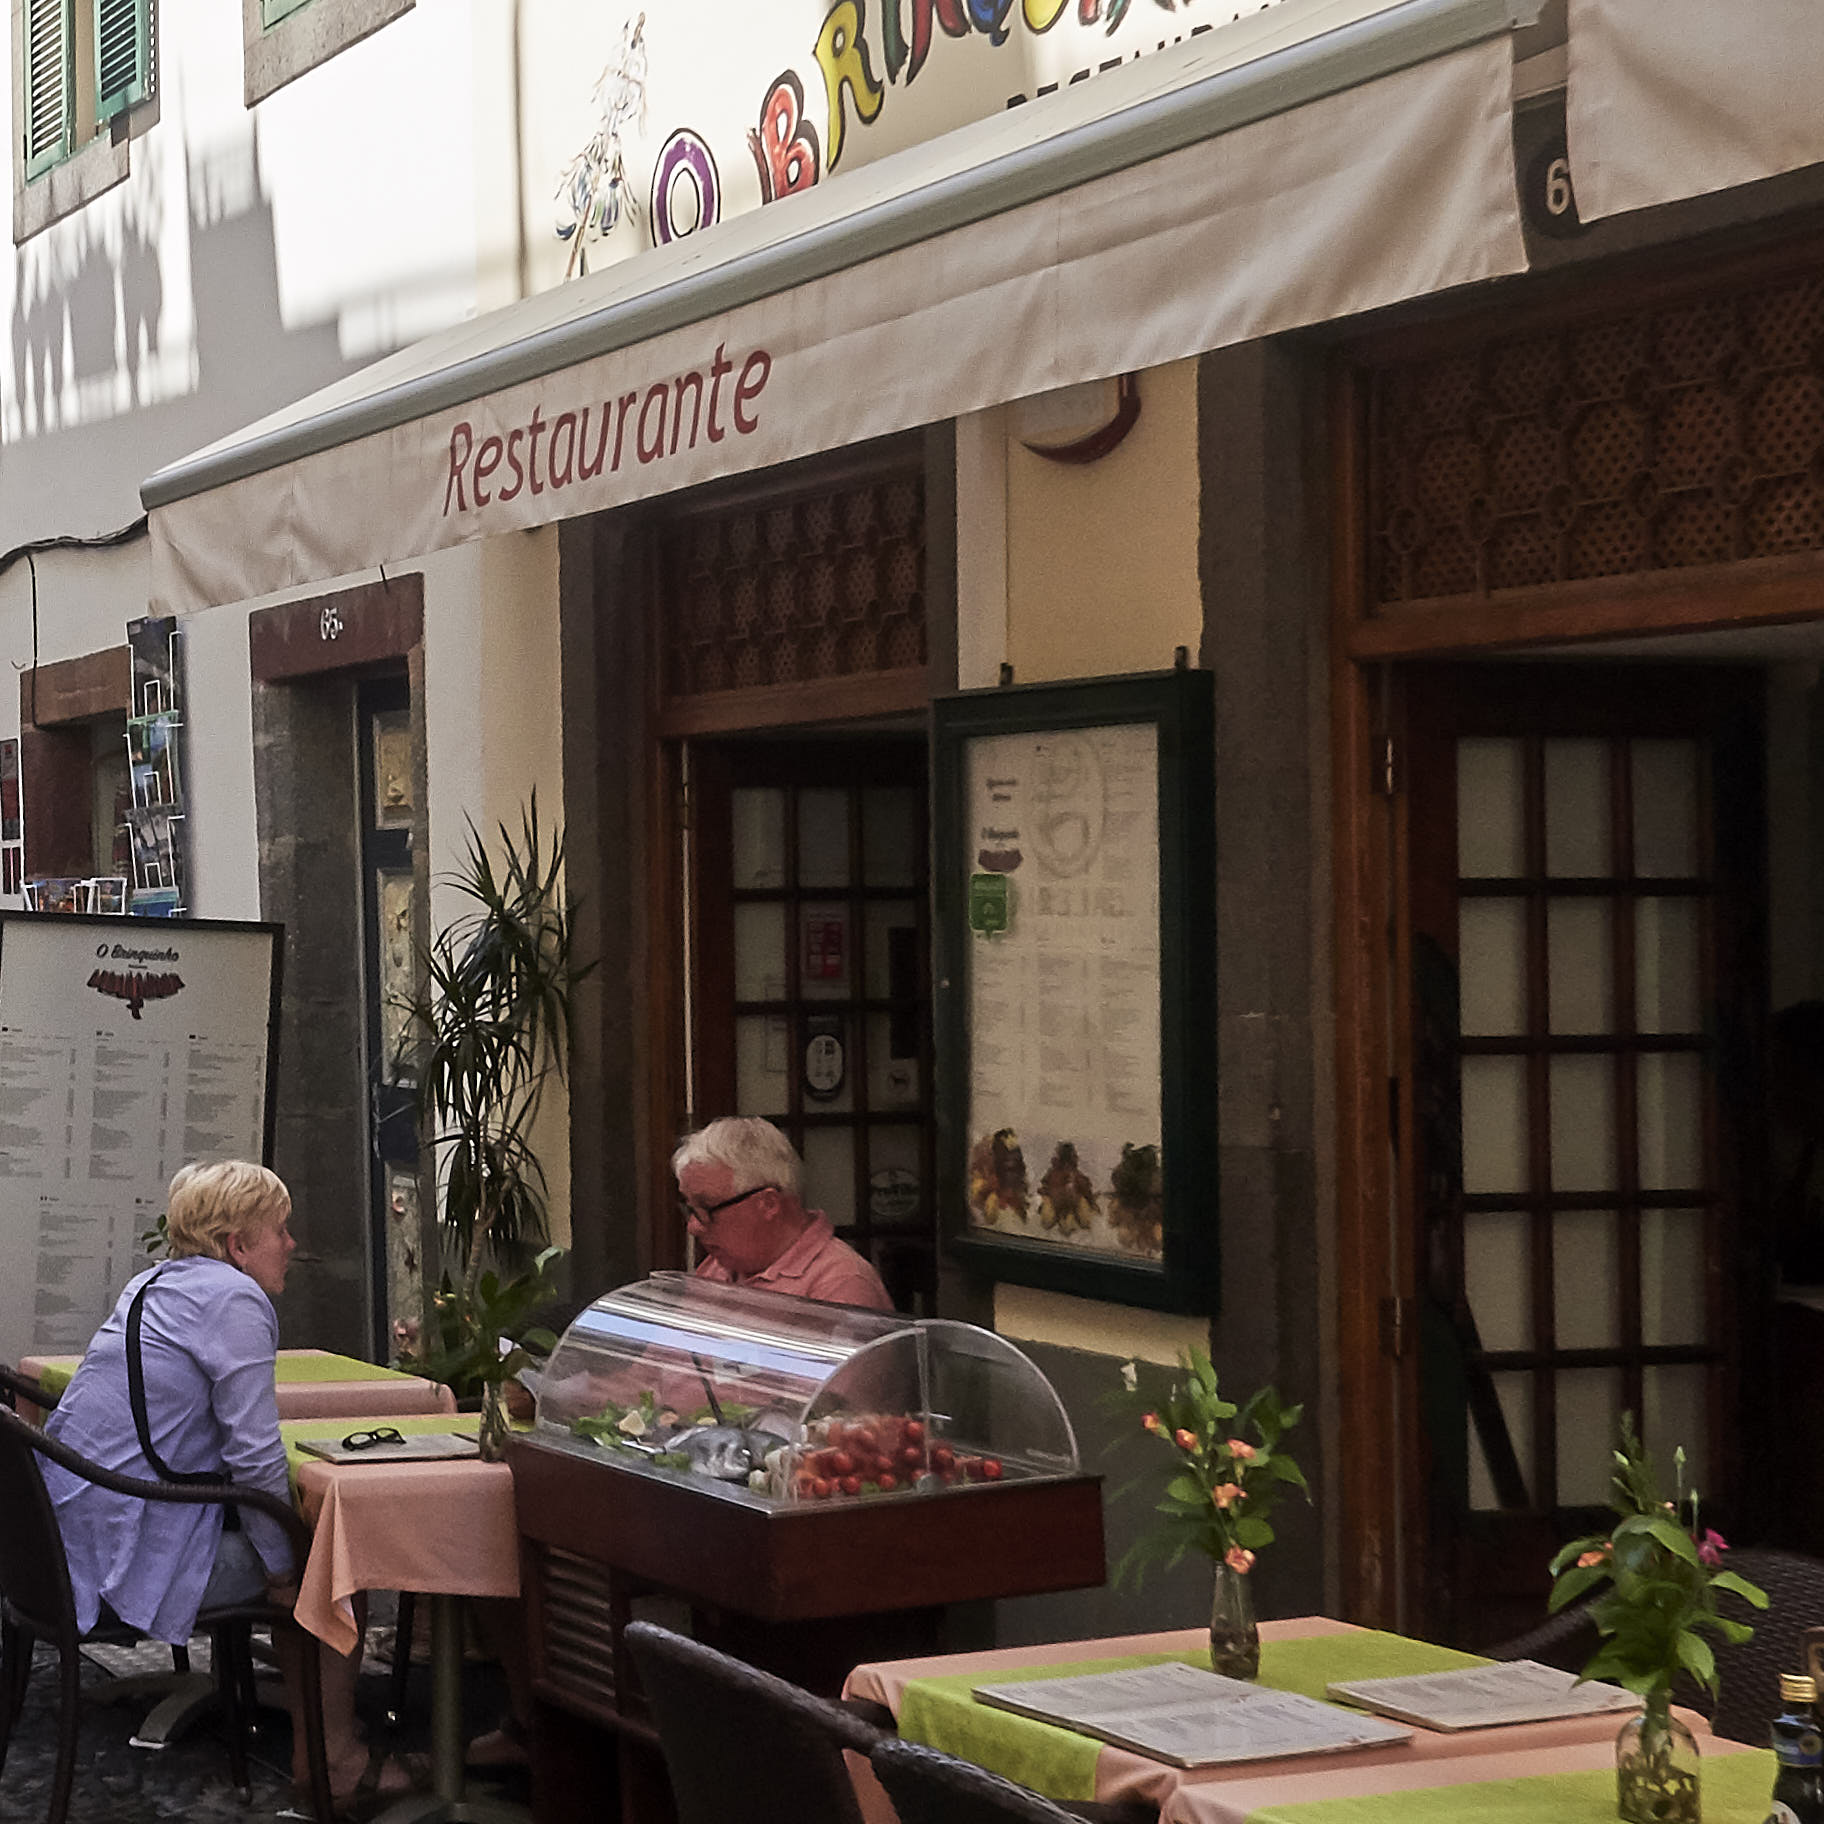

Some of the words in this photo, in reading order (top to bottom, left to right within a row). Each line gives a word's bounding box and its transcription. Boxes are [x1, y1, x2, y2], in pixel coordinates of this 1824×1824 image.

[650, 127, 722, 248] O
[442, 341, 772, 517] Restaurante
[96, 943, 109, 957] O
[111, 943, 180, 963] Brinquinho
